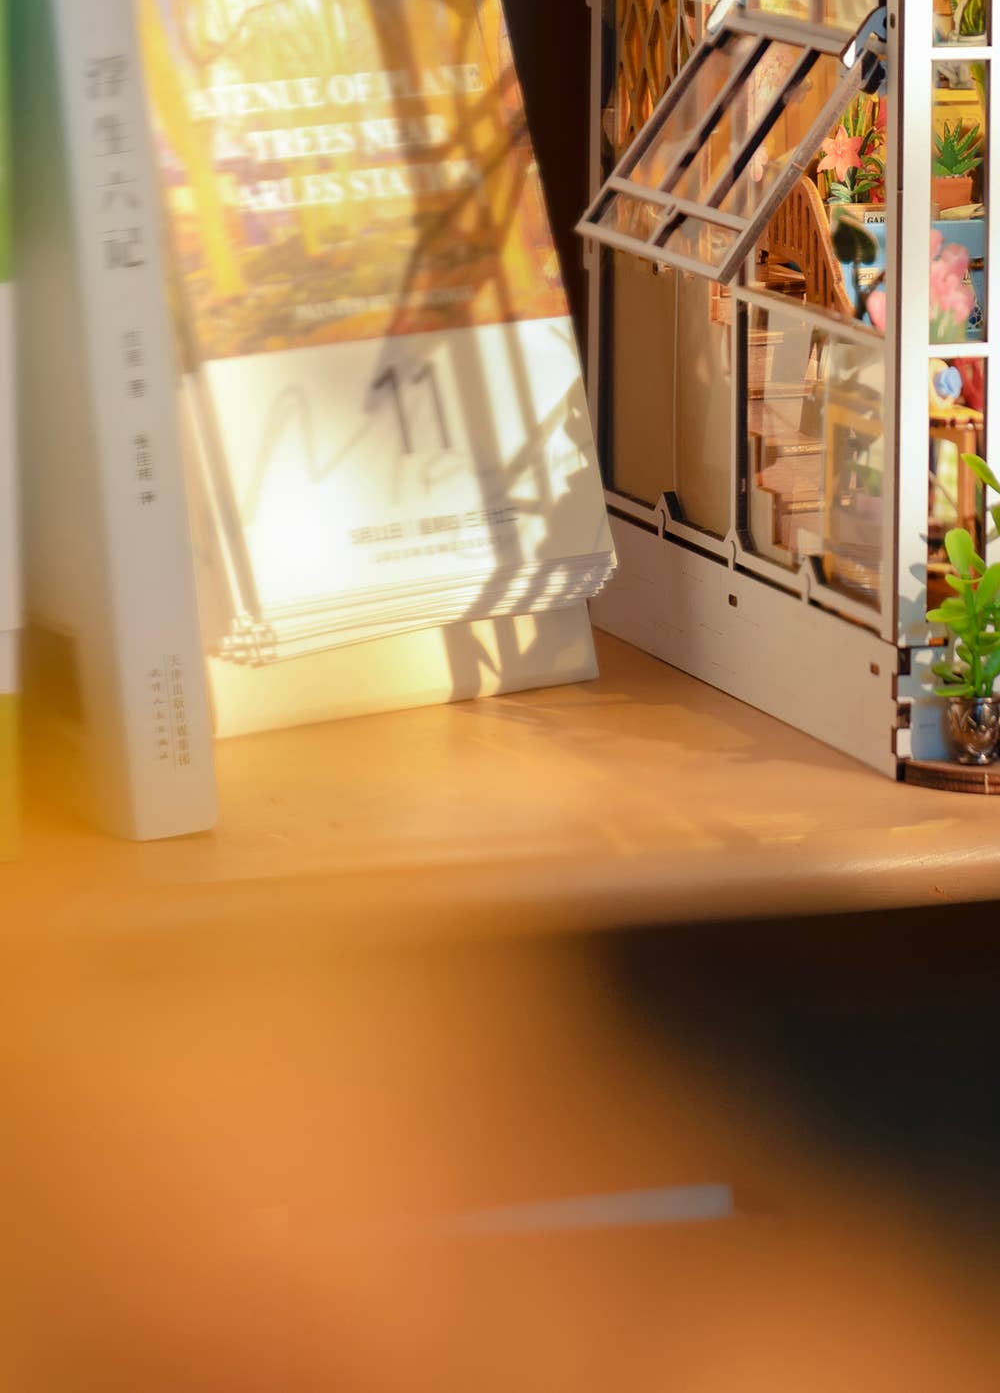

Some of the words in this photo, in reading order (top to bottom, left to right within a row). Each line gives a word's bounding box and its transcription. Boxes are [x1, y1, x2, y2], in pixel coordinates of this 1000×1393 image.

[328, 70, 373, 105] OF
[246, 121, 355, 162] TREES
[373, 363, 453, 454] 11
